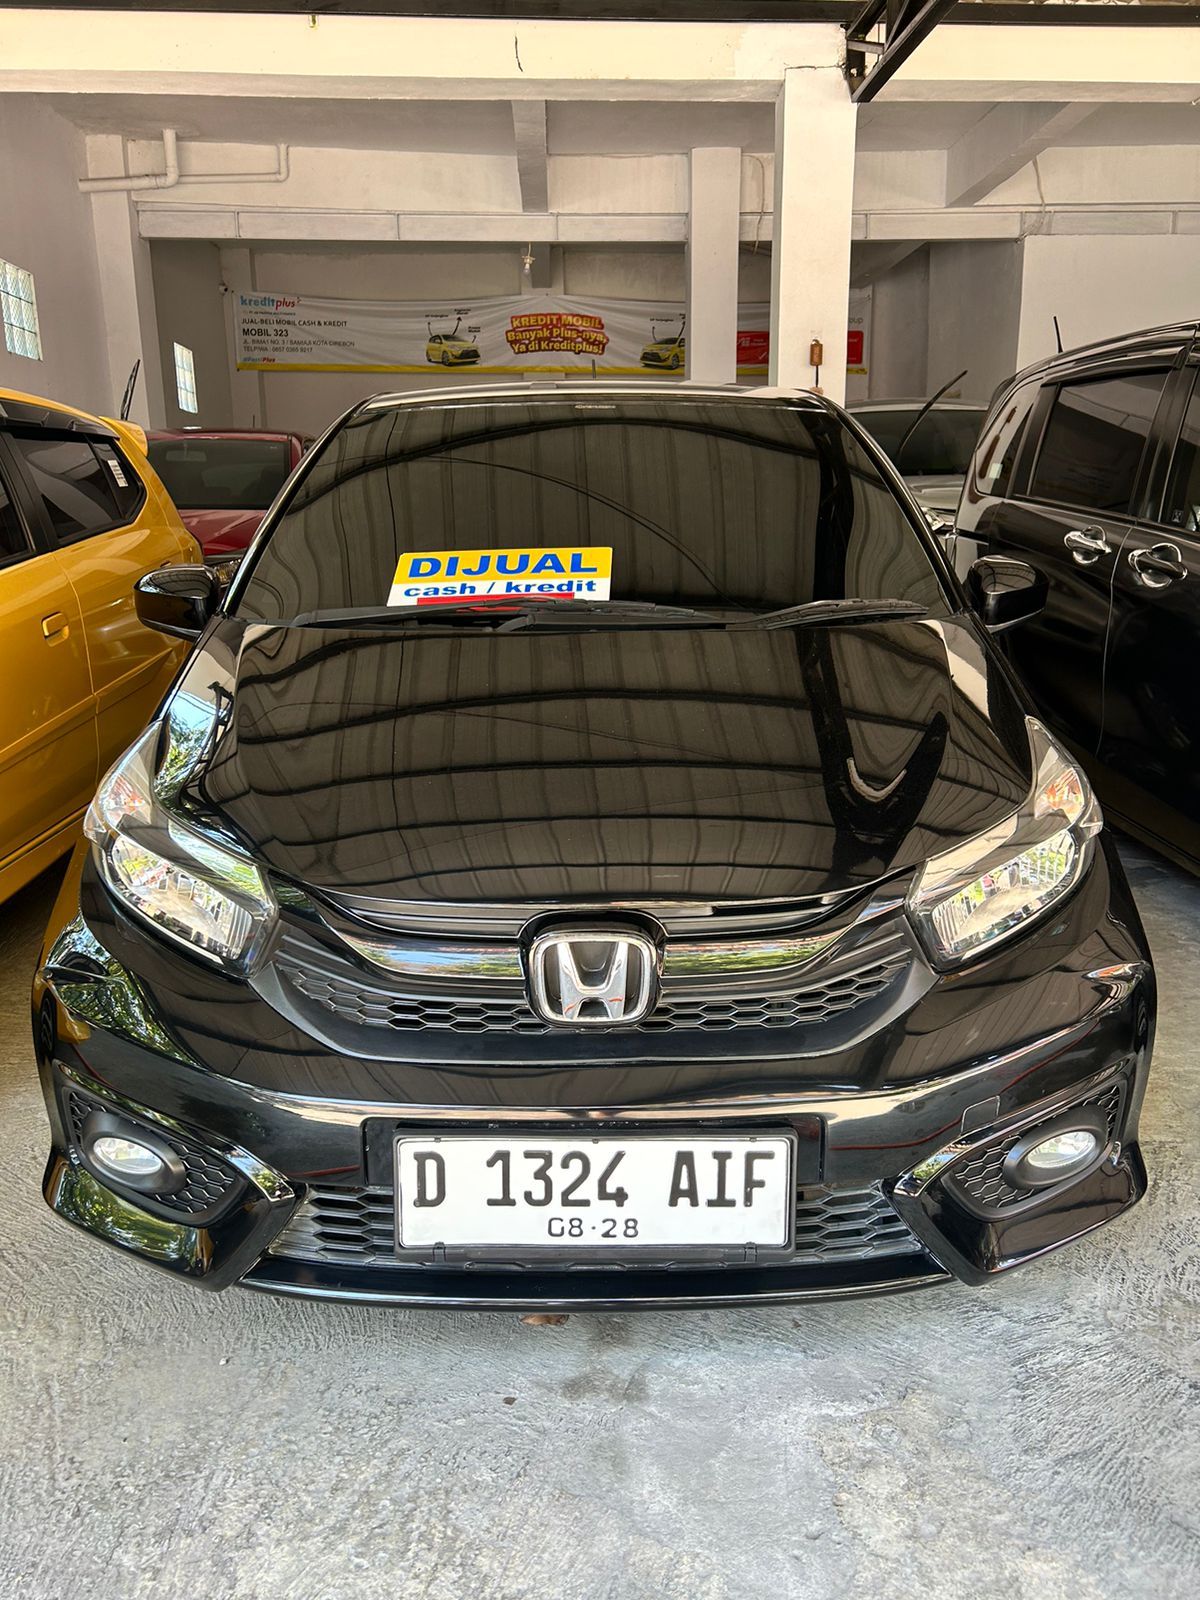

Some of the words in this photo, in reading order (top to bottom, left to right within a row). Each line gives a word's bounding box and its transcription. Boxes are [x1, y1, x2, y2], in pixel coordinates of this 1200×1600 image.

[240, 296, 296, 310] kreditplus
[241, 318, 275, 326] JUAL-BELI
[276, 319, 297, 327] MOBIL
[323, 320, 347, 328] KREDIT
[512, 315, 560, 328] KREDIT
[561, 315, 602, 328] MOBIL
[242, 328, 272, 337] MOBIL
[273, 329, 289, 338] 323
[507, 328, 551, 341] Banyak
[552, 328, 607, 343] Plus-nya,
[512, 343, 527, 353] Ya
[528, 341, 539, 351] di
[540, 340, 603, 354] Kreditplus!
[408, 553, 597, 578] DIJUAL
[404, 583, 475, 597] cash
[486, 582, 496, 594] /
[505, 580, 597, 594] kredit
[413, 1151, 446, 1207] D
[486, 1150, 629, 1207] 1324
[667, 1150, 775, 1207] AIF
